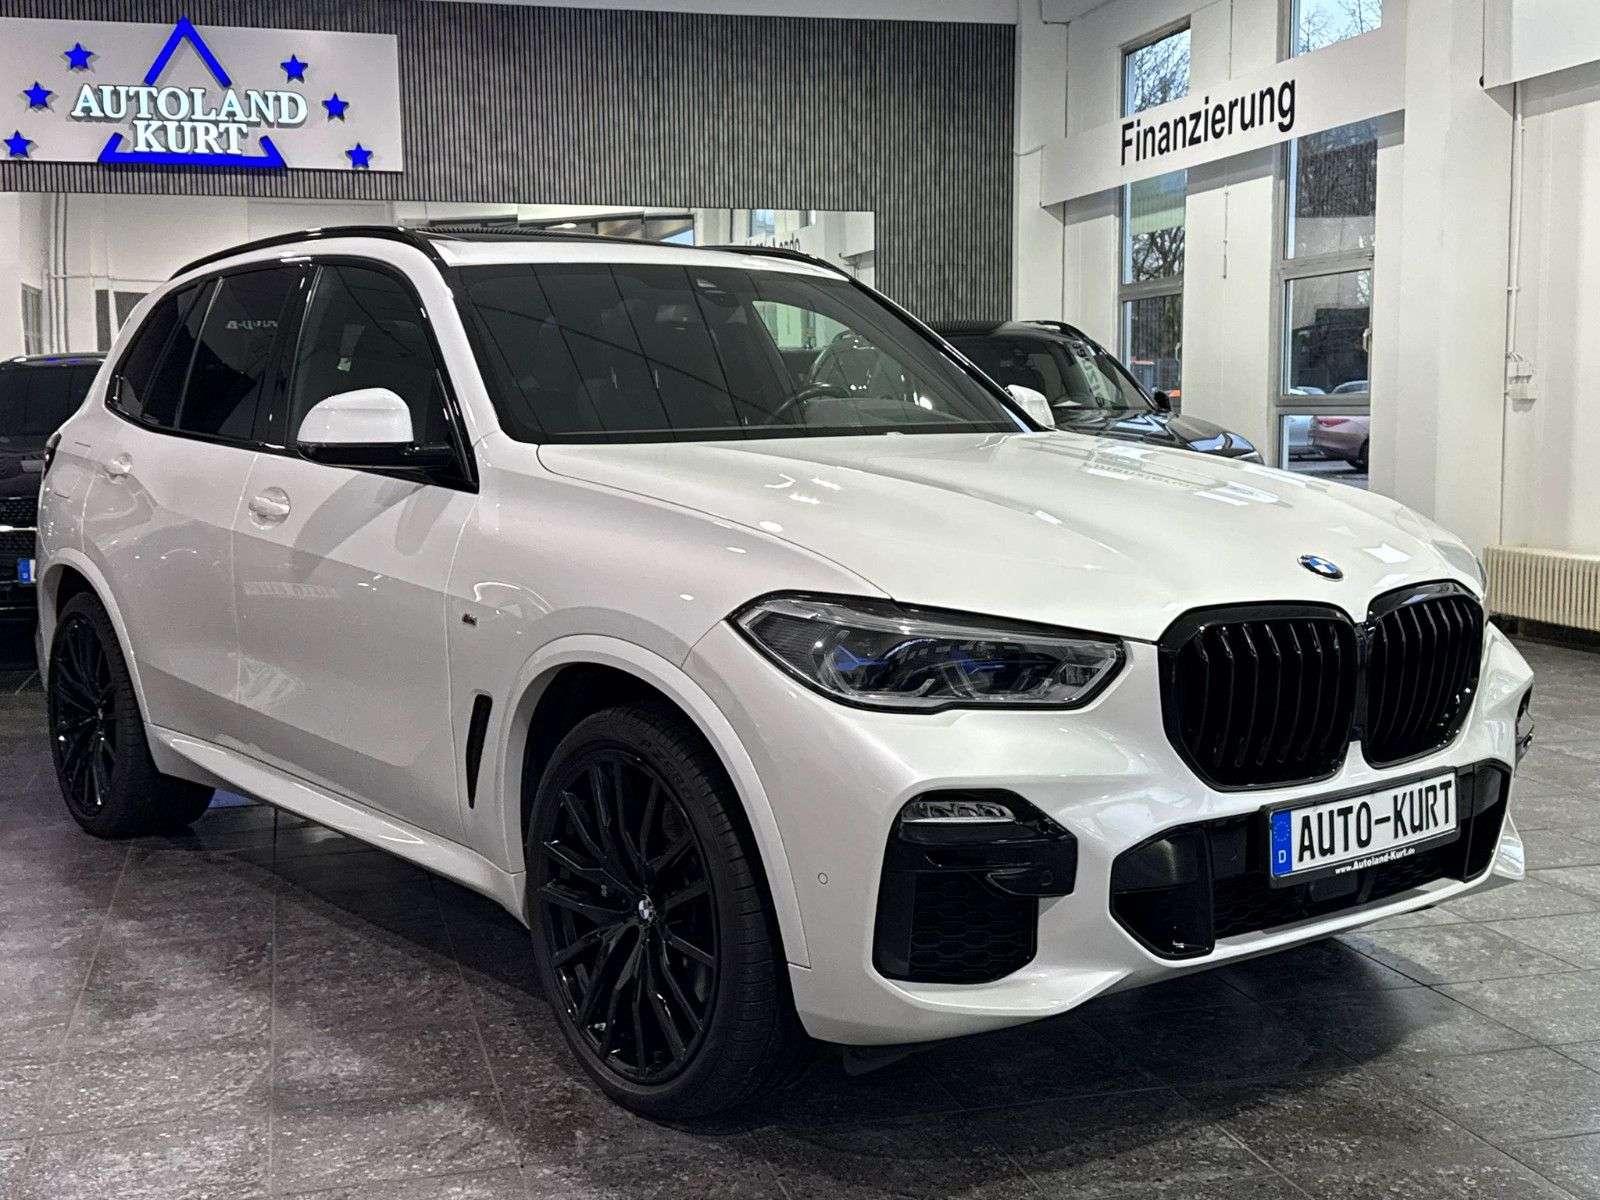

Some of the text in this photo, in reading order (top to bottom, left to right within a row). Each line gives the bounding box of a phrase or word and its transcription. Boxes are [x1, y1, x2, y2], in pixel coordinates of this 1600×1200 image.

[71, 84, 308, 127] AUTOLAND
[1120, 79, 1296, 167] Finanzierung
[133, 119, 248, 156] KURT
[1298, 780, 1453, 863] AUTO-KURT
[1278, 850, 1287, 864] D
